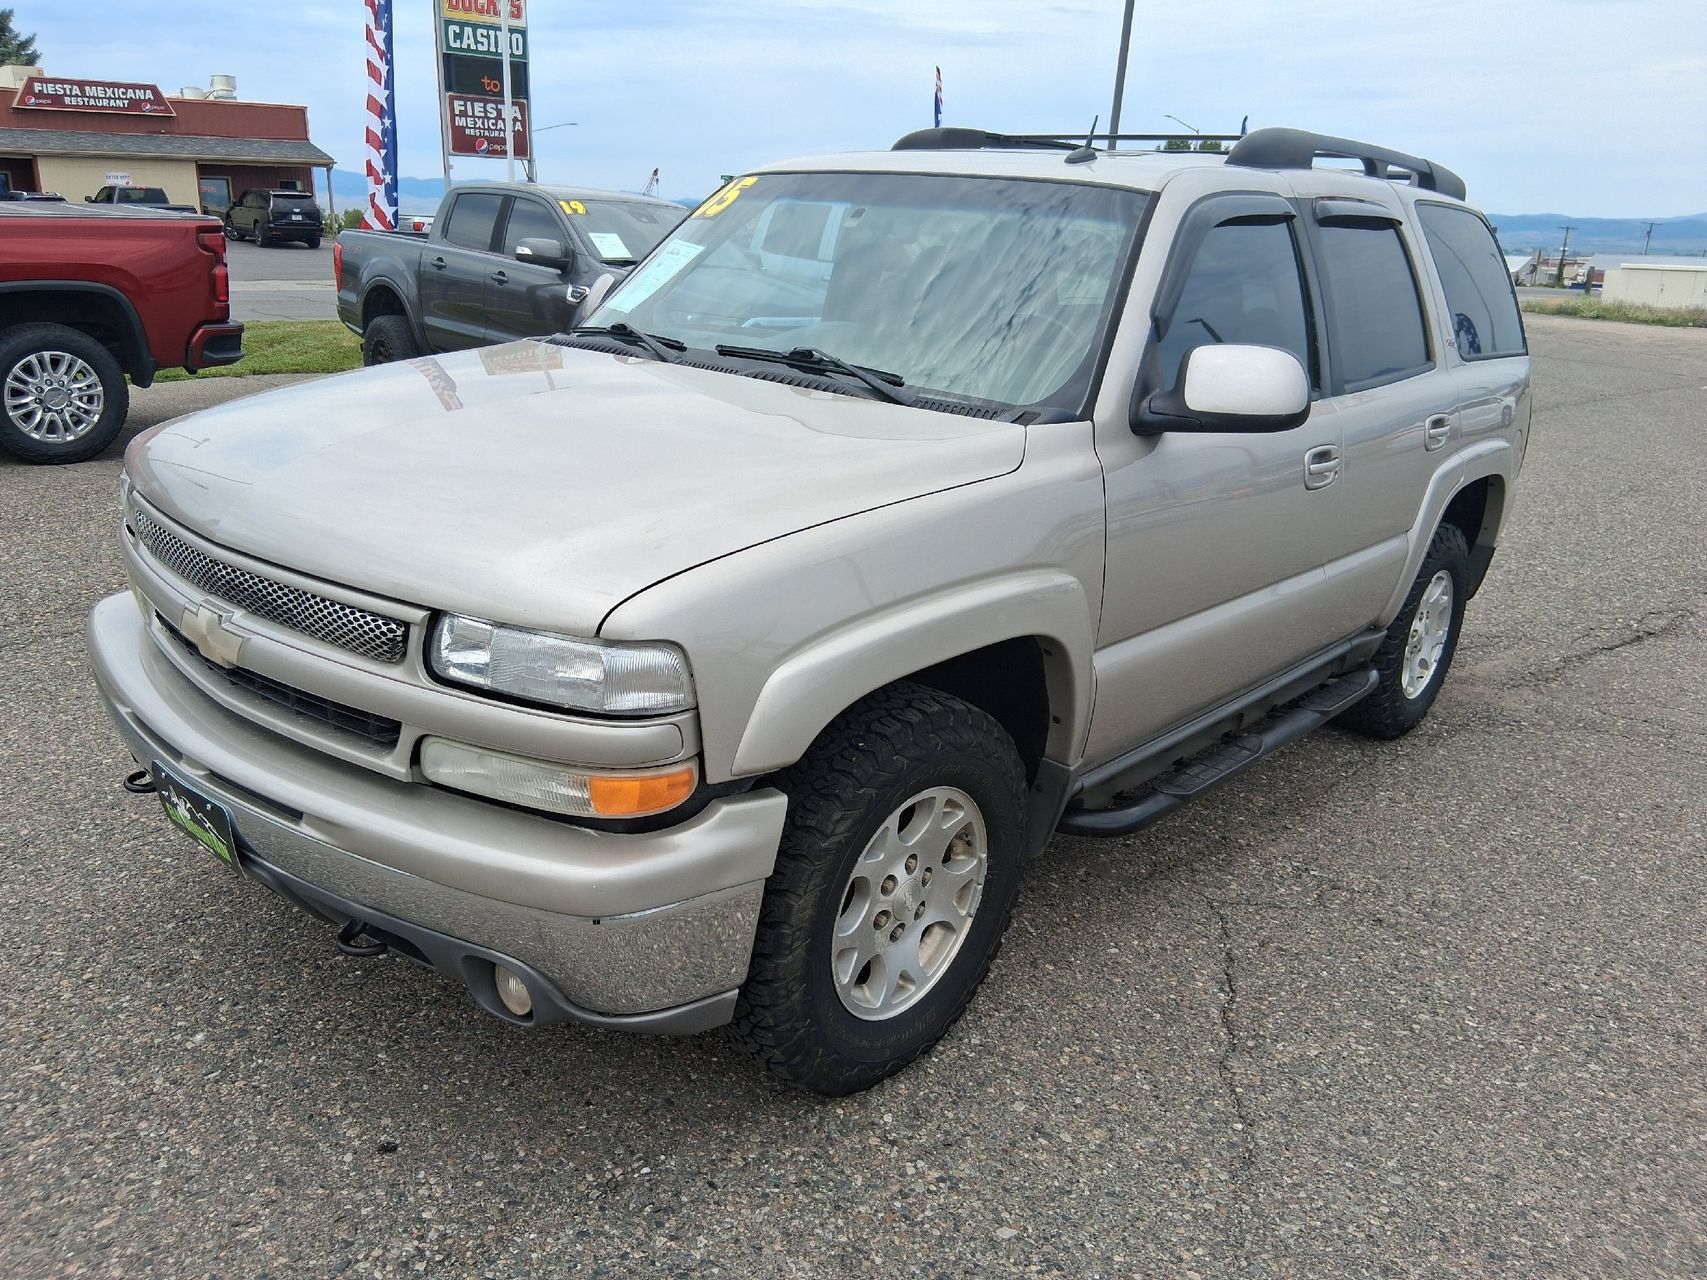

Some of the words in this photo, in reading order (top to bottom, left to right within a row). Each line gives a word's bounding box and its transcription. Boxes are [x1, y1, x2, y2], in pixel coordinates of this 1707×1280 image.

[448, 24, 523, 56] CASINO
[33, 82, 81, 97] FIESTA
[85, 86, 155, 101] MEXICANA
[481, 75, 501, 92] to
[64, 96, 129, 109] RESTAURANT
[453, 100, 522, 120] FIESTA
[454, 116, 523, 132] MEXICAA
[559, 200, 587, 215] 19
